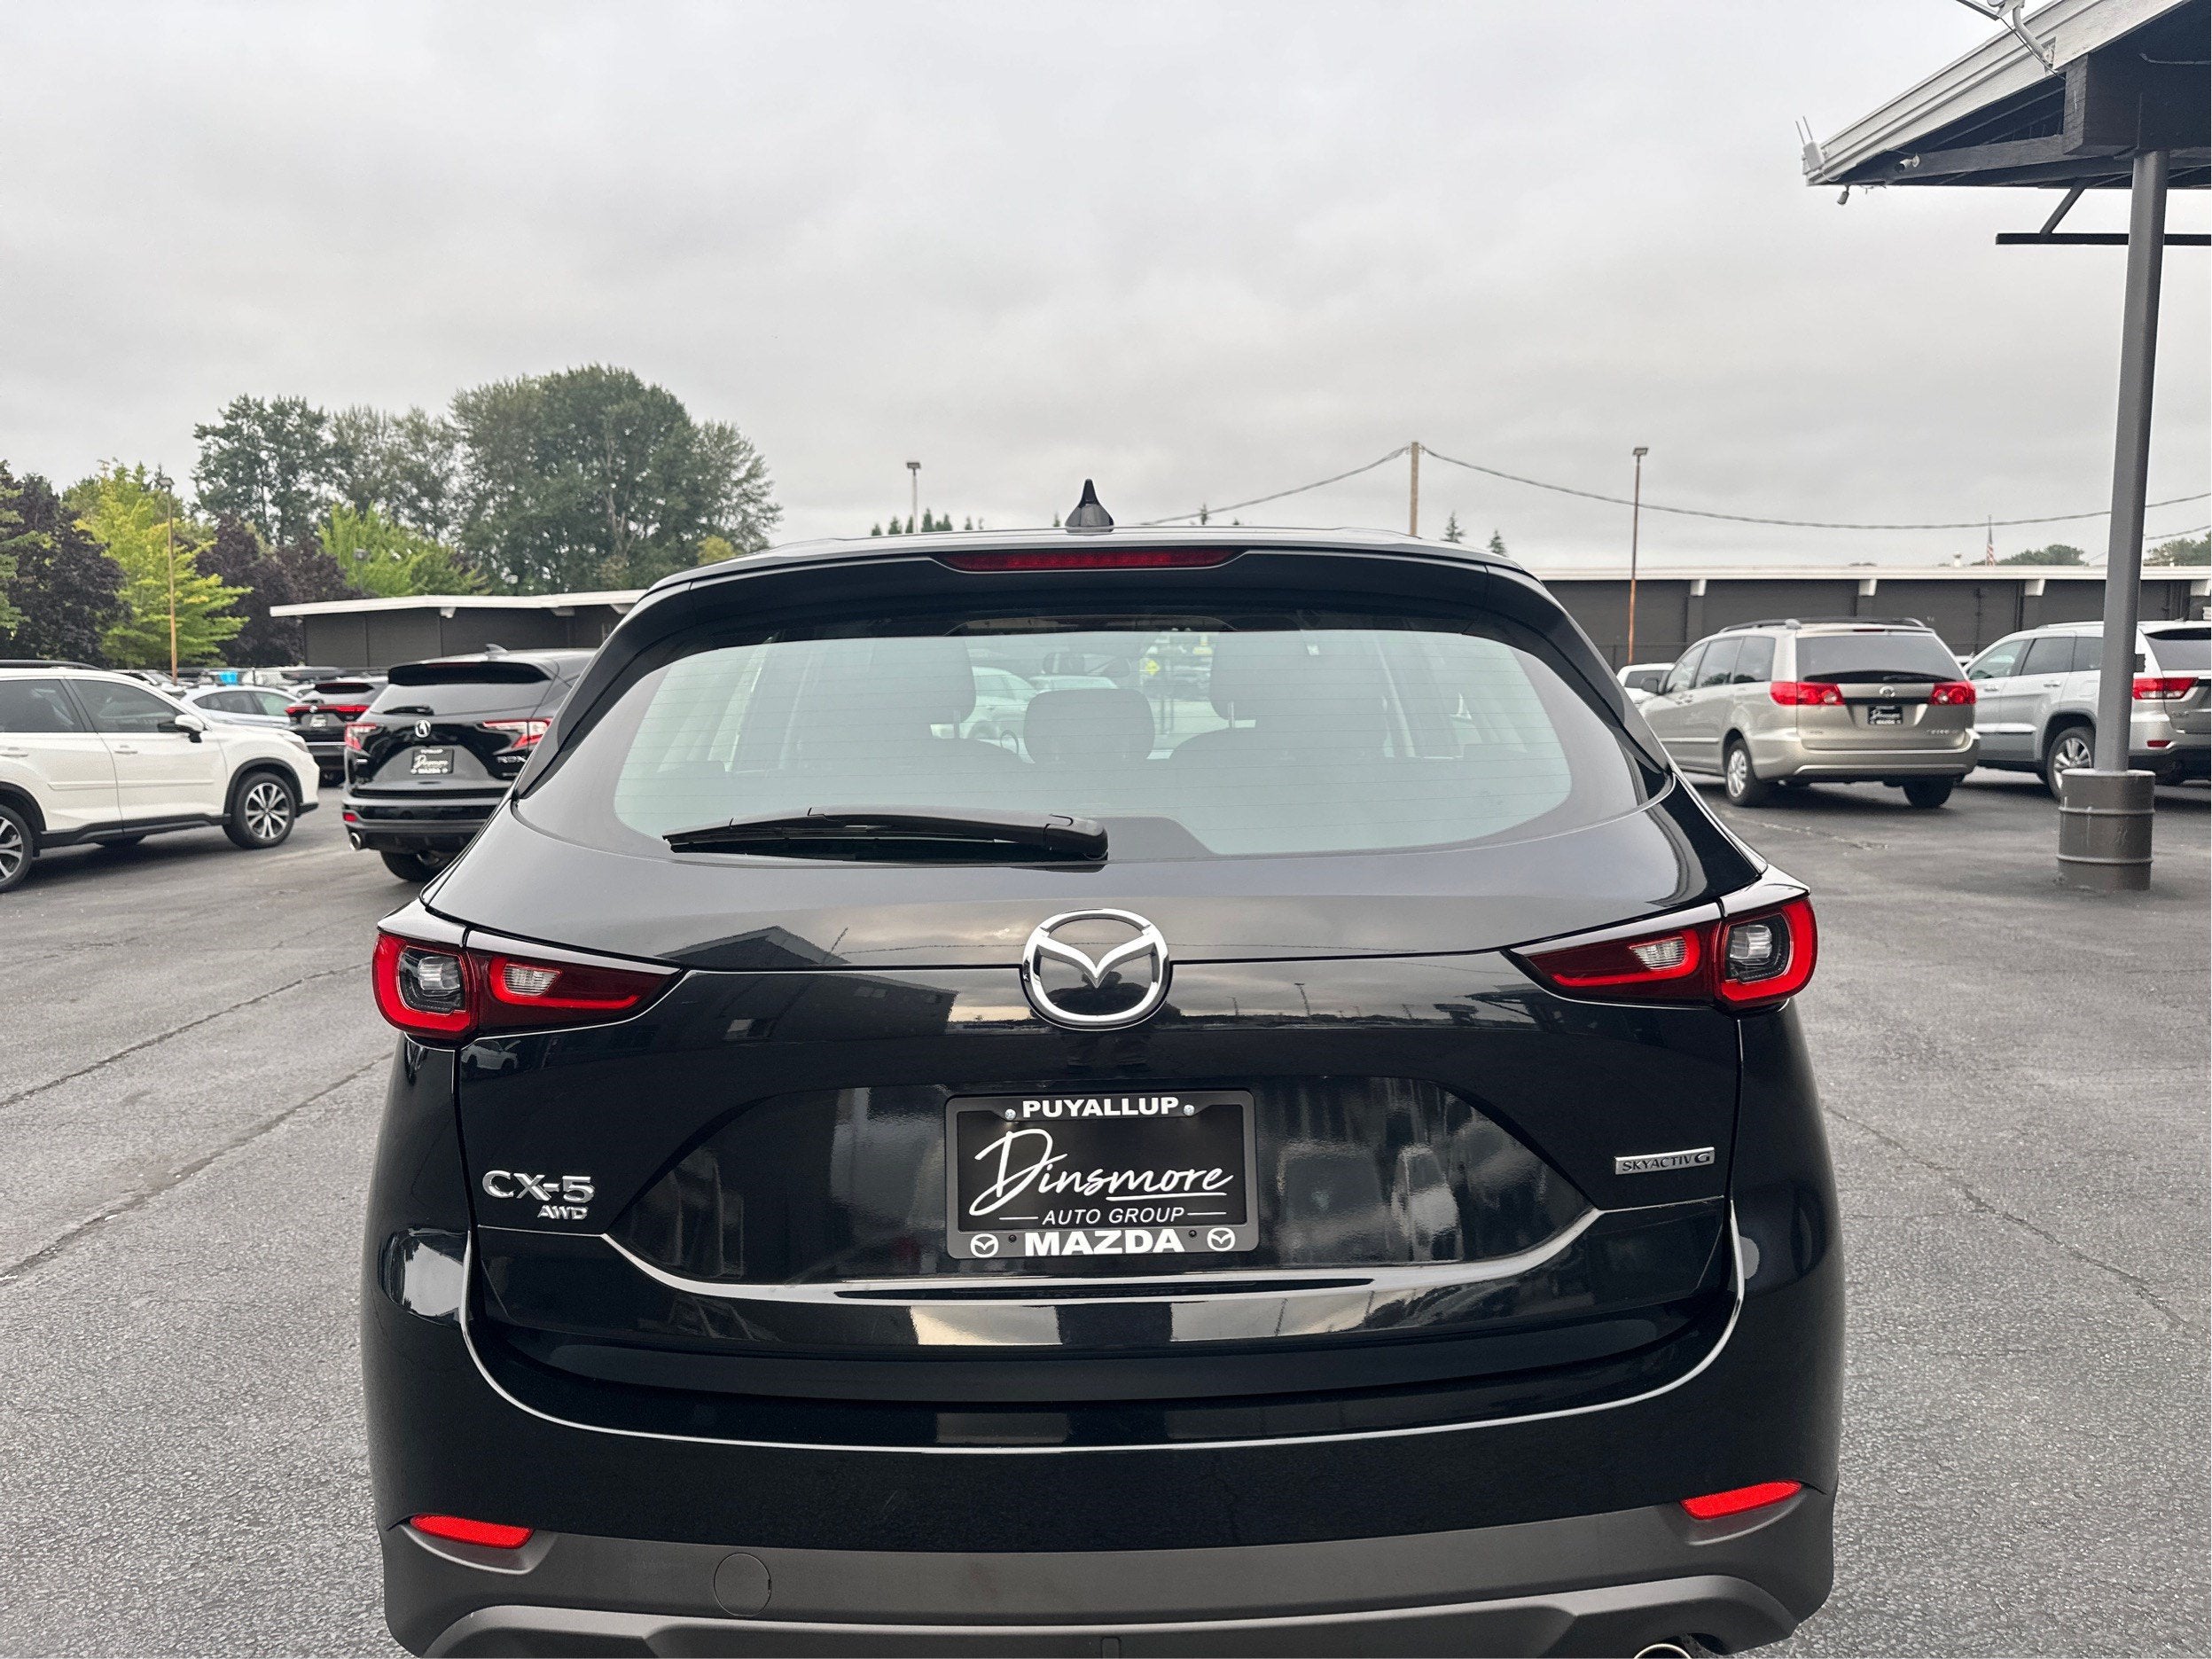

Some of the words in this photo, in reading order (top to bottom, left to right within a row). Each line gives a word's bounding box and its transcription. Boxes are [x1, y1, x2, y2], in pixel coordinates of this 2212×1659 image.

[1022, 1097, 1179, 1118] PUYALLUP
[969, 1129, 1233, 1216] Dinsmore
[482, 1170, 596, 1203] CX-5
[536, 1204, 589, 1220] AWD
[1042, 1209, 1101, 1225] AUTO
[1108, 1207, 1184, 1224] GROUP
[1024, 1228, 1185, 1256] MAZDA
